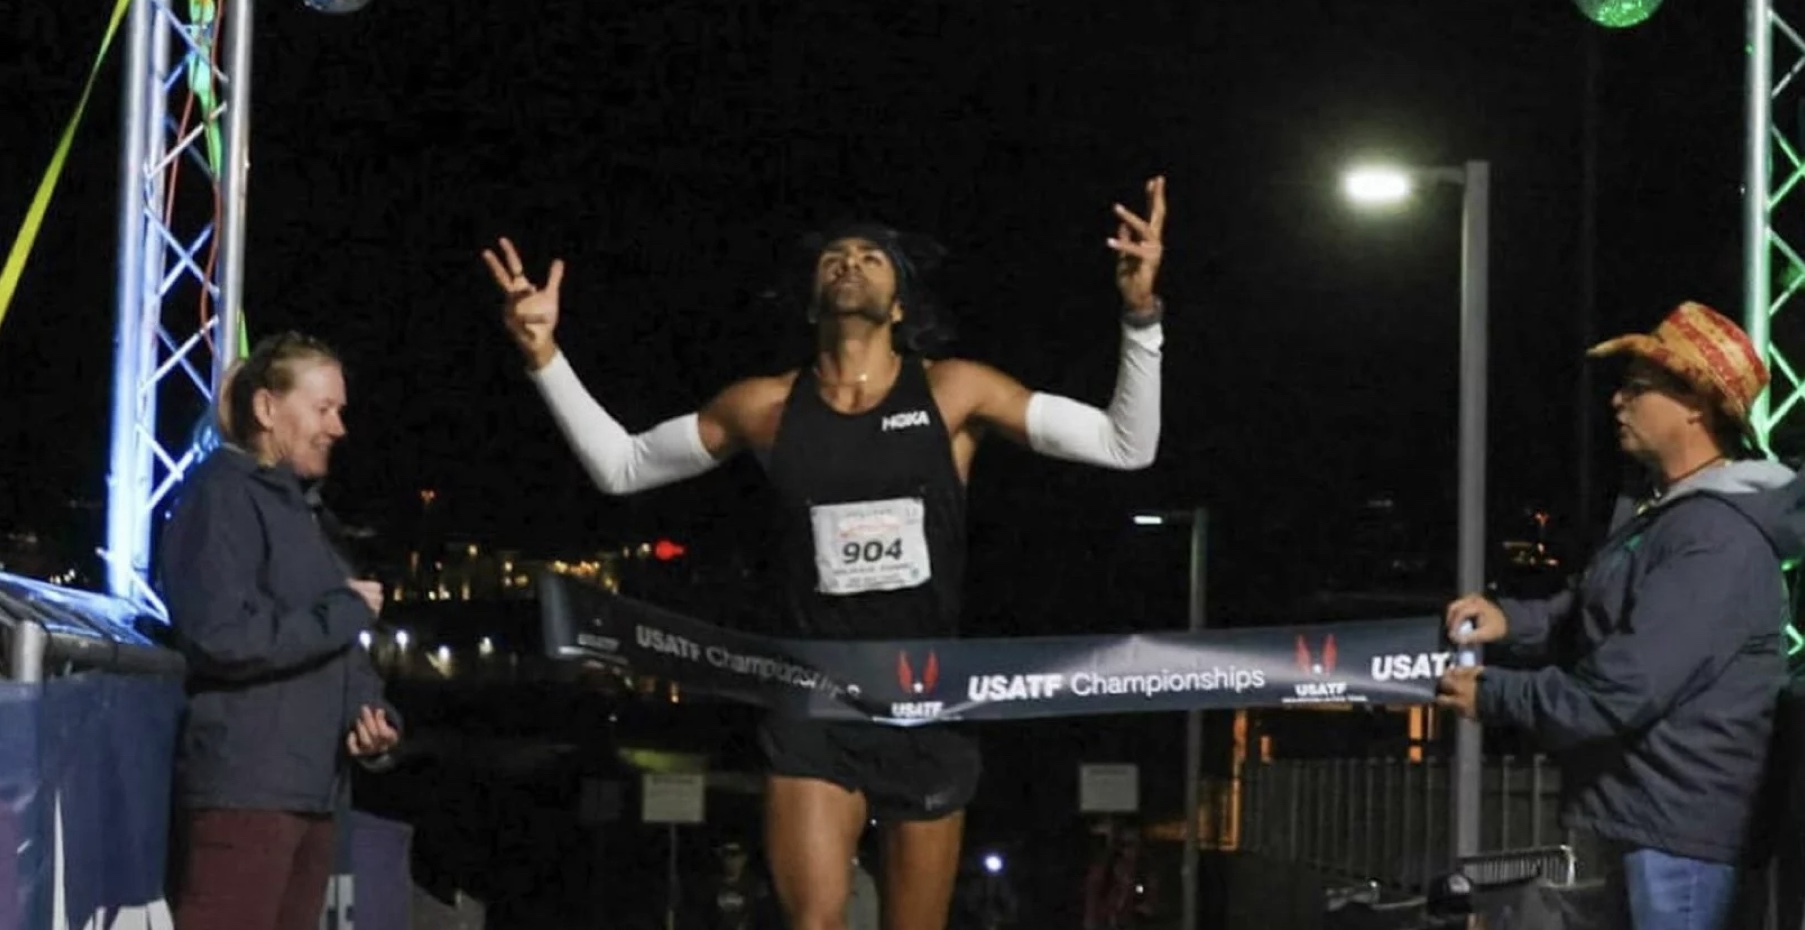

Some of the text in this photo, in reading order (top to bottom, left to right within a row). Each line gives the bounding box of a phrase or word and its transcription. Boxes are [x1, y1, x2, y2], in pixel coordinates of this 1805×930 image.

[881, 410, 930, 432] HOKA
[842, 538, 903, 565] 904
[1370, 651, 1452, 681] USAT
[968, 666, 1266, 702] USATF Championships
